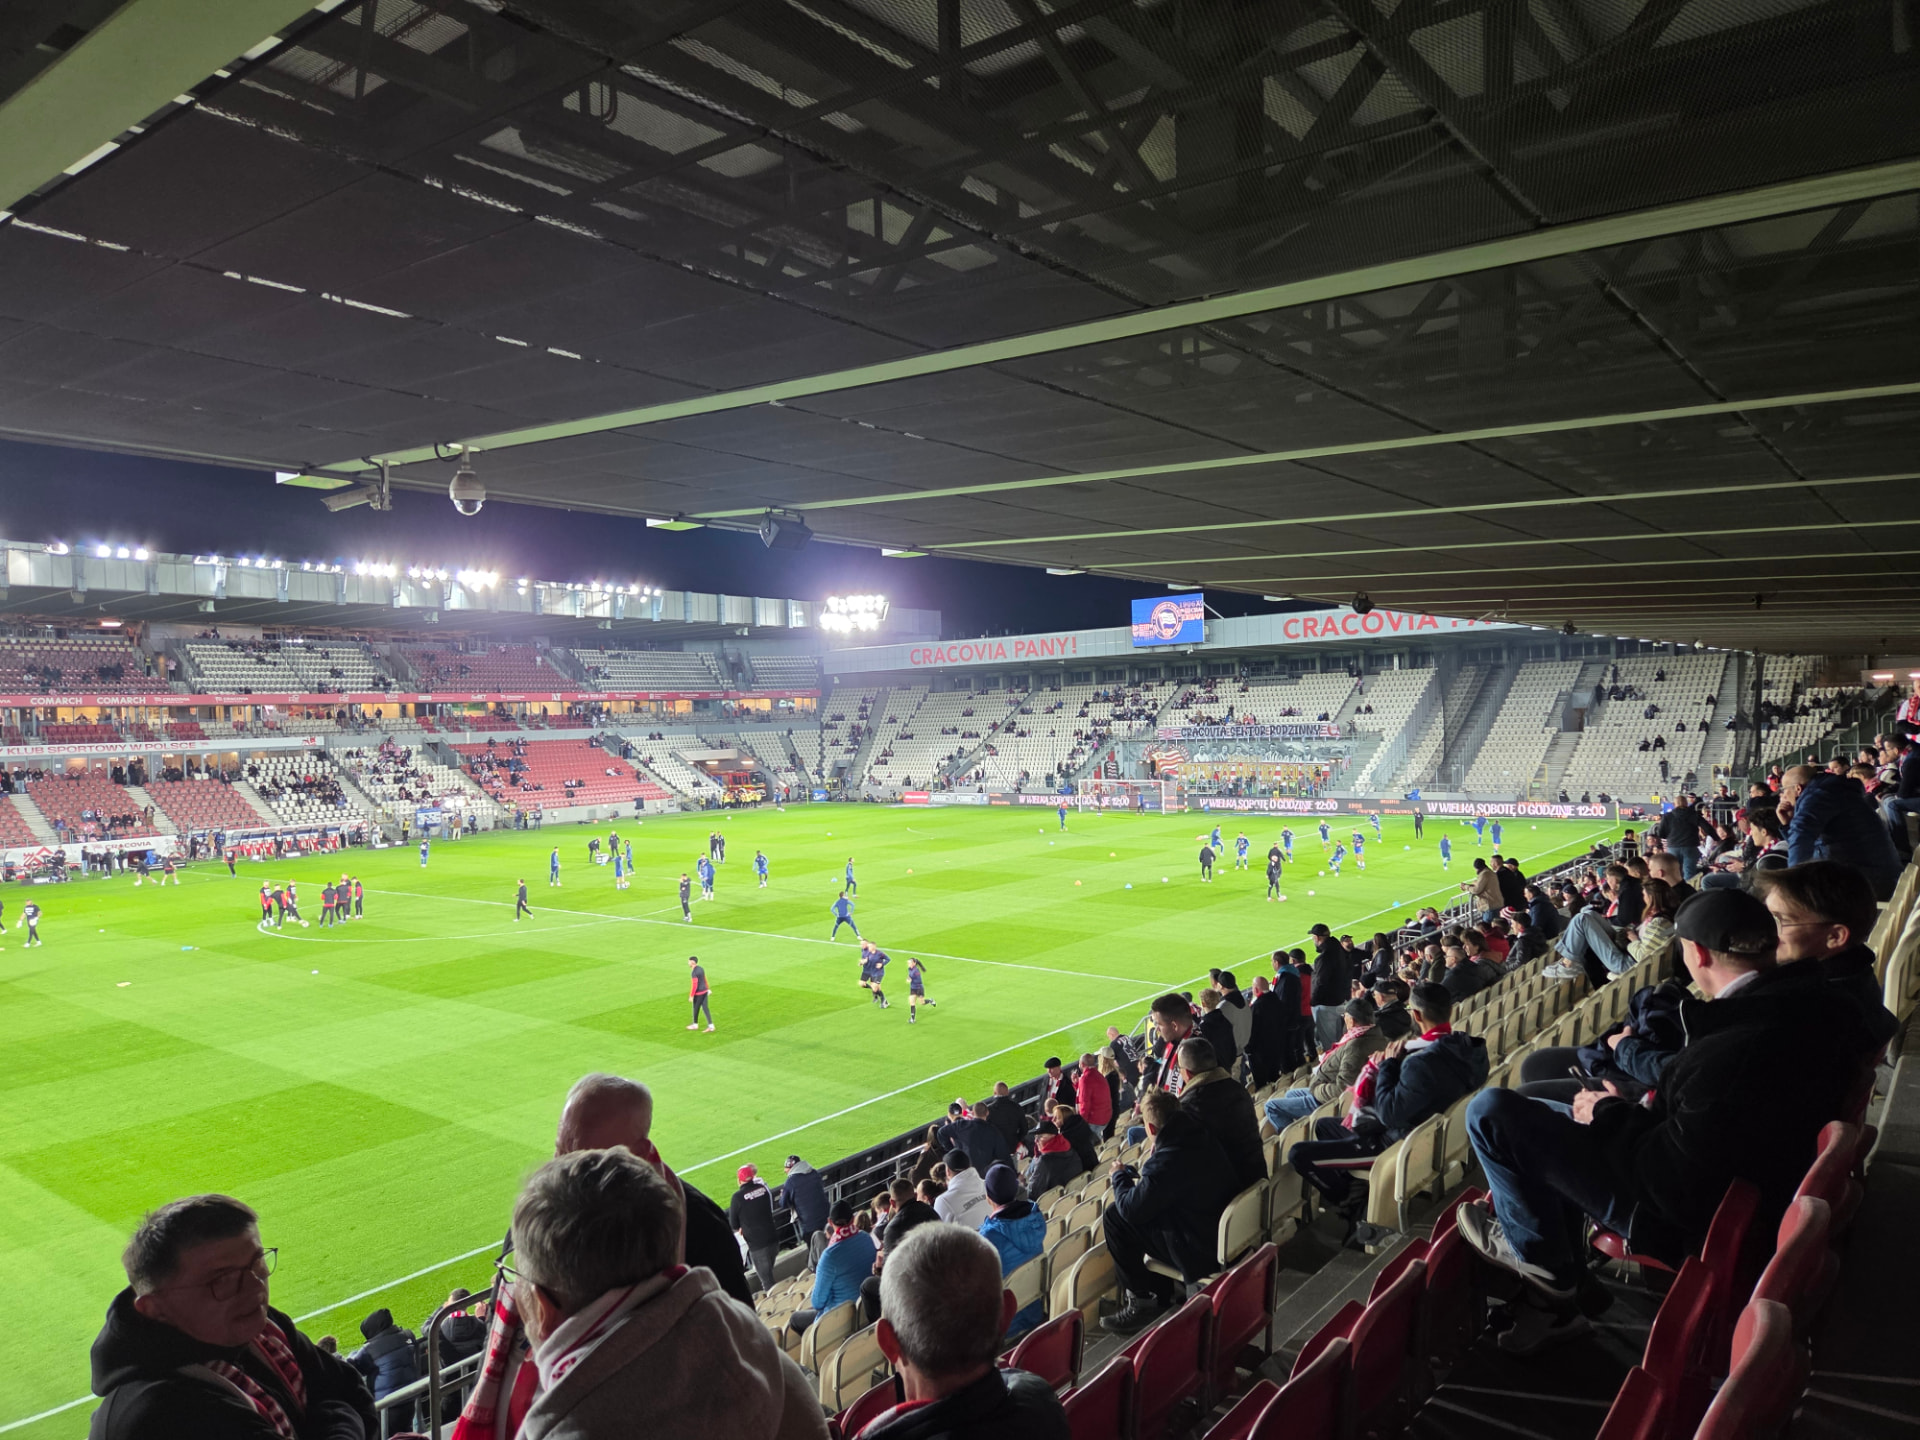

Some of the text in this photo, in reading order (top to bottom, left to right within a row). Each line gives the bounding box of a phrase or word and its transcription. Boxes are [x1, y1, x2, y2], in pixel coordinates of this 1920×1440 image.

[1283, 611, 1439, 639] CRACOVIA
[910, 636, 1077, 665] CRACOVIA PANY!
[30, 697, 83, 705] COMARCH
[96, 696, 146, 704] COMARCH
[1181, 724, 1321, 738] CRACOVIA SEKTOR RODZINNY
[7, 746, 44, 756] KLUB
[50, 744, 127, 755] SPORTOWY
[130, 743, 143, 751] W
[145, 741, 196, 751] POLSCE
[1315, 800, 1339, 811] 12:00
[1427, 802, 1607, 817] W WIELKĄ SOBOTĘ O GODZINIE 12:00
[105, 841, 152, 850] CRACOVIA
